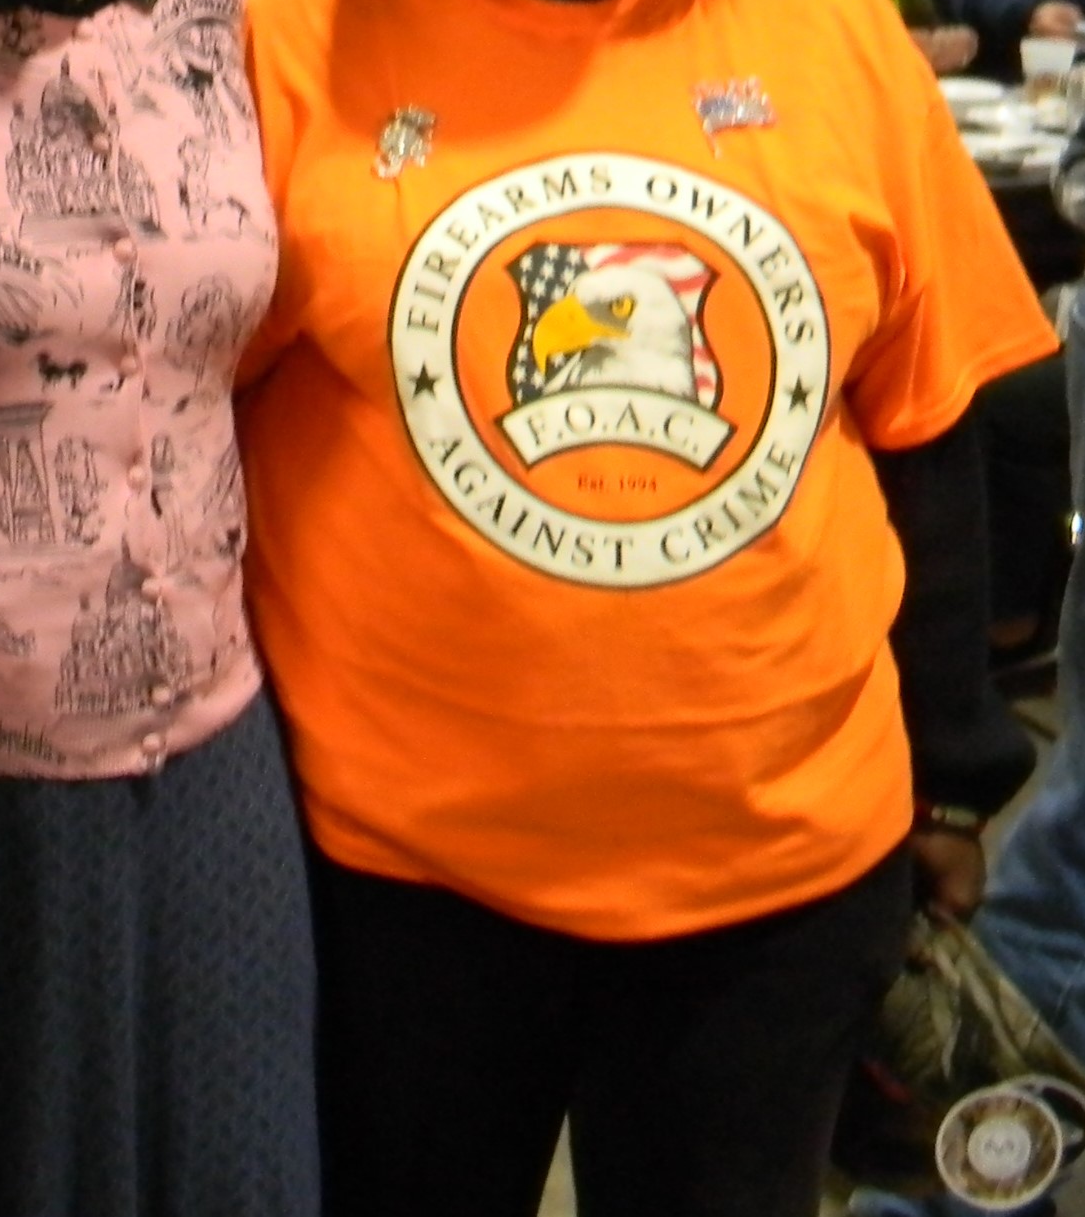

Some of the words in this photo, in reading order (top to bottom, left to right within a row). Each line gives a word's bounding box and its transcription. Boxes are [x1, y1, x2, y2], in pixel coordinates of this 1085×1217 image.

[406, 163, 613, 336] FIREARMS
[646, 173, 815, 347] OWNERS
[523, 398, 701, 454] F.O.A.C.
[429, 435, 634, 570] AGAINST
[660, 440, 799, 564] CRIME
